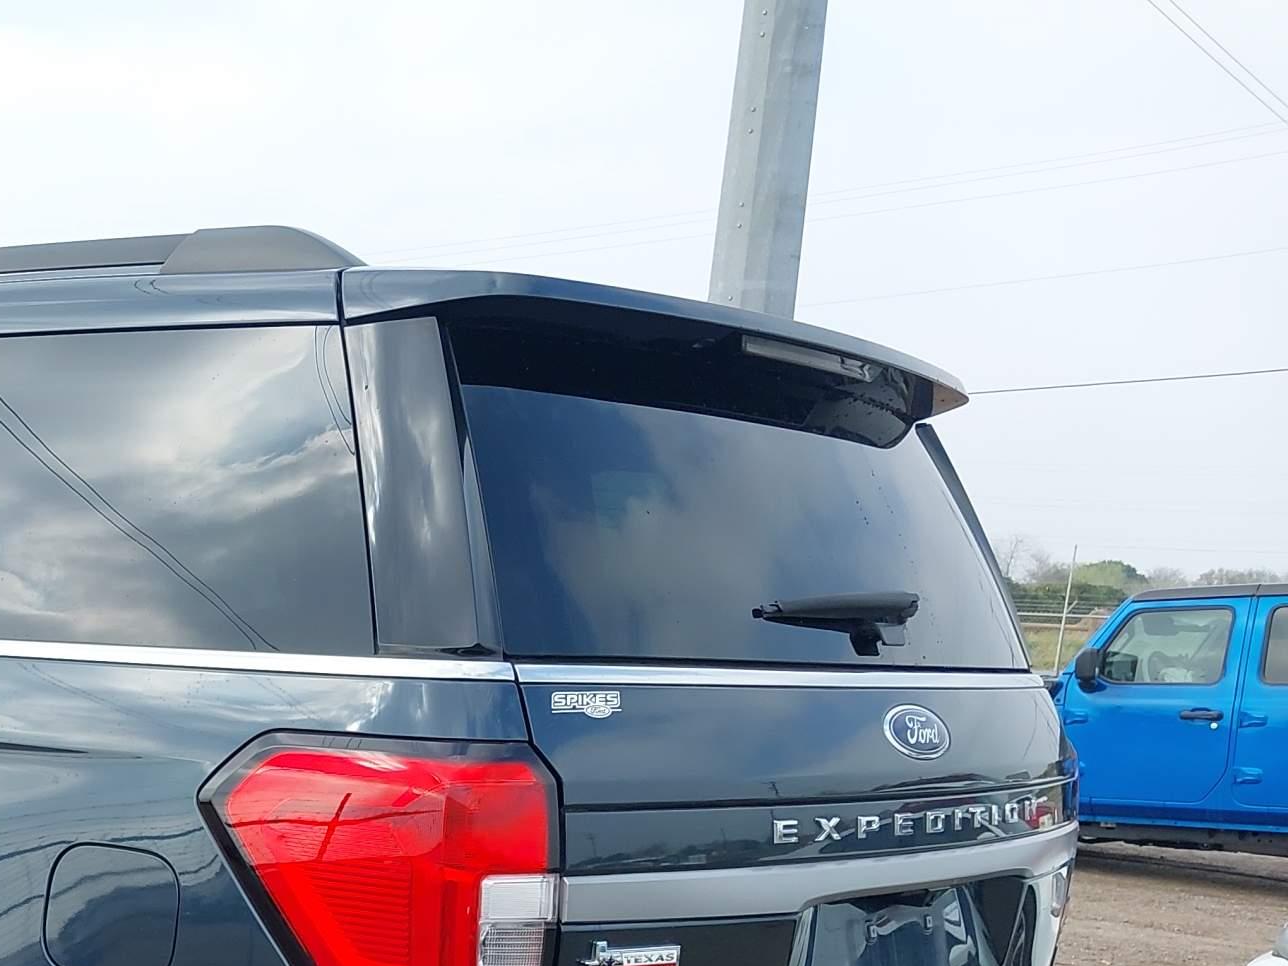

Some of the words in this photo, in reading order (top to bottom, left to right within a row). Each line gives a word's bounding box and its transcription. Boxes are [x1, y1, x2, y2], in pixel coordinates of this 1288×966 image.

[553, 693, 618, 706] SPIKES
[905, 715, 940, 745] Ford
[773, 796, 1048, 844] EXPEDITION
[624, 953, 675, 964] TEXAS
